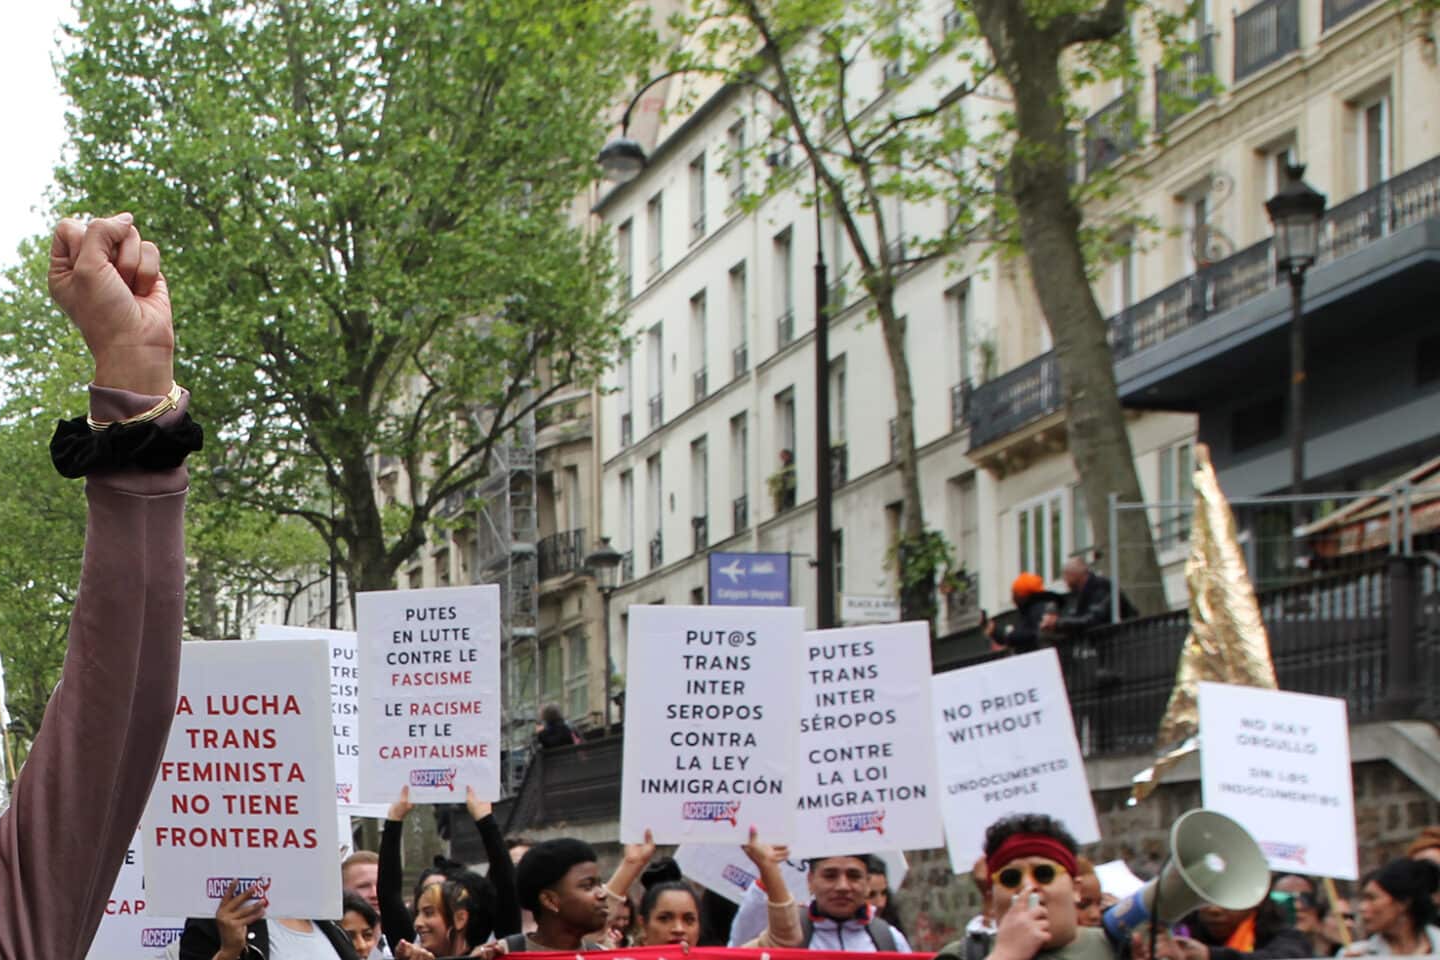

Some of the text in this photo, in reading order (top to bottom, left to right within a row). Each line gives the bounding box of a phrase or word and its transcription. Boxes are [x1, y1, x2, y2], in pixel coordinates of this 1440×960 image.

[405, 606, 458, 622] PUTES
[392, 627, 471, 644] EN LUTTE
[686, 630, 758, 647] PUT@S
[386, 648, 478, 666] CONTRE LE
[808, 641, 875, 661] PUTES
[682, 654, 752, 671] TRANS
[391, 670, 473, 687] FASCISME
[808, 664, 879, 685] TRANS
[686, 679, 746, 695] INTER
[206, 694, 302, 716] LUCHA
[815, 688, 876, 707] INTER
[942, 687, 1040, 722] NO PRIDE
[384, 701, 483, 717] LE RACISME
[666, 704, 764, 720] SEROPOS
[408, 723, 453, 738] ET LE
[800, 709, 898, 733] SÉROPOS
[948, 710, 1043, 743] WITHOUT
[185, 728, 278, 750] TRANS
[670, 731, 758, 747] CONTRA
[378, 744, 489, 760] CAPITALISME
[808, 743, 894, 764] CONTRE
[161, 761, 306, 783] FEMINISTA
[676, 755, 750, 771] LA LEY
[640, 776, 784, 795] INMIGRACIÓN
[816, 766, 888, 786] LA LOI
[947, 758, 1068, 796] UNDOCUMENTED
[983, 782, 1038, 802] PEOPLE
[171, 793, 300, 816] NO TIENE
[155, 826, 319, 850] FRONTERAS
